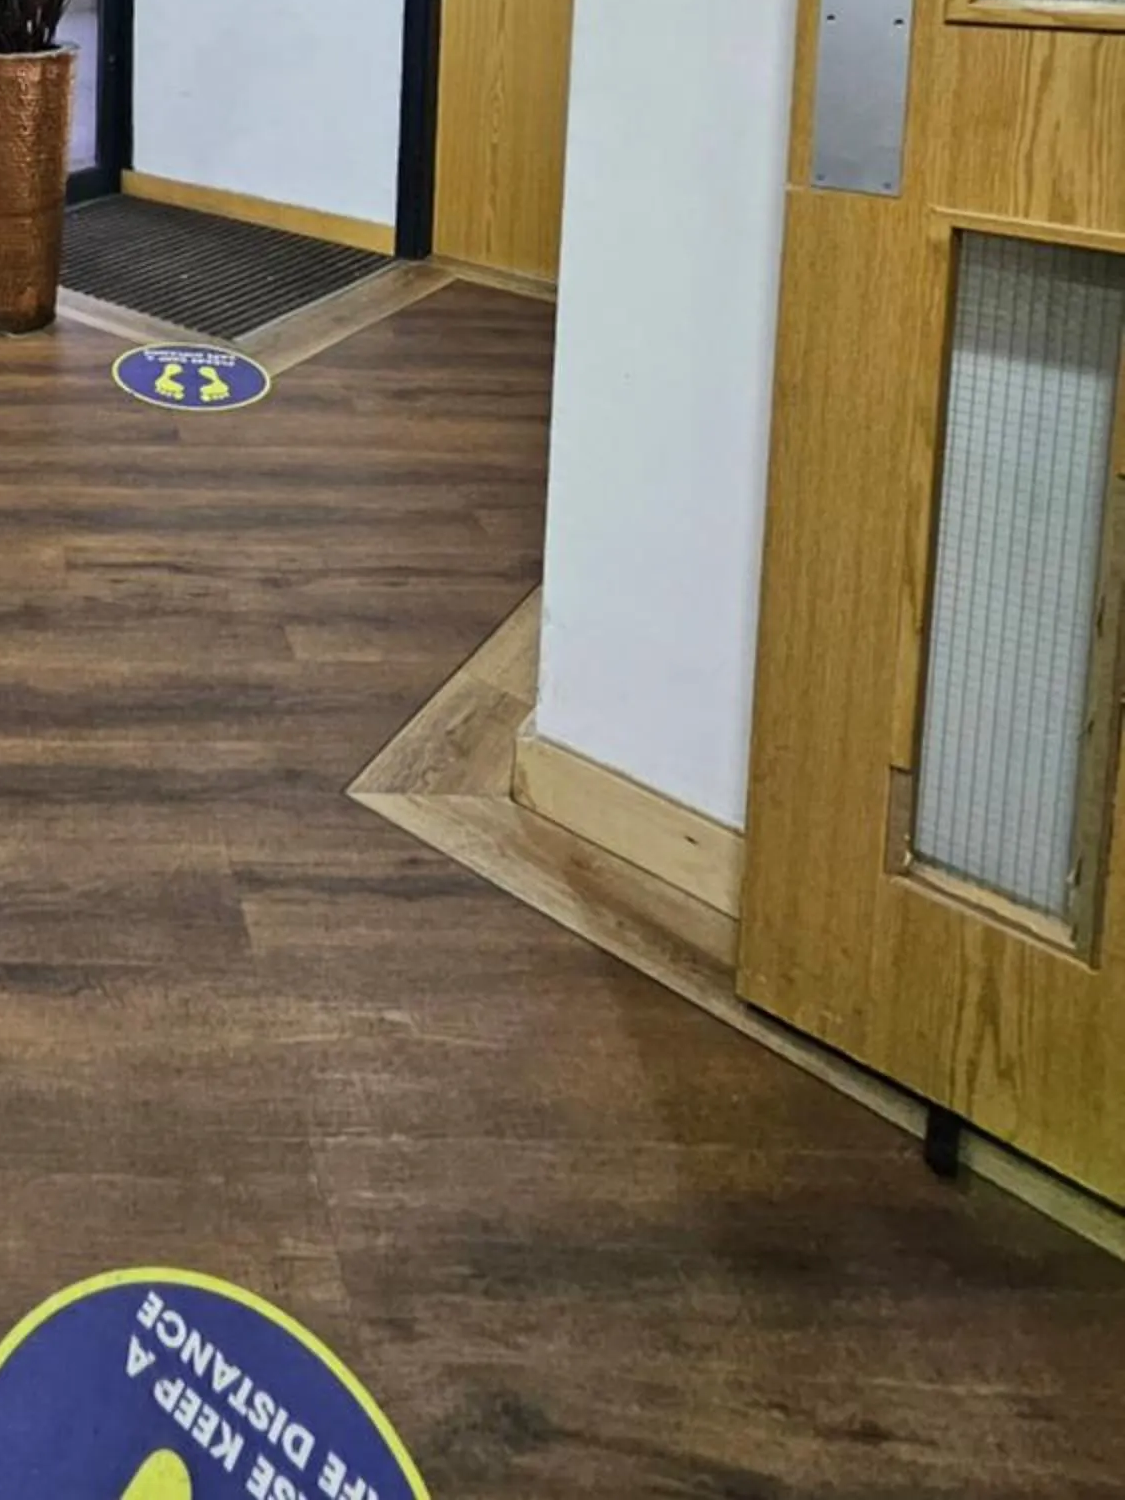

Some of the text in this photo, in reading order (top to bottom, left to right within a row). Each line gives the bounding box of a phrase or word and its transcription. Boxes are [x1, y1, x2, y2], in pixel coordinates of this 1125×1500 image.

[125, 1333, 156, 1378] A
[135, 1289, 316, 1472] DISTANCE
[153, 1377, 245, 1473] KEEP
